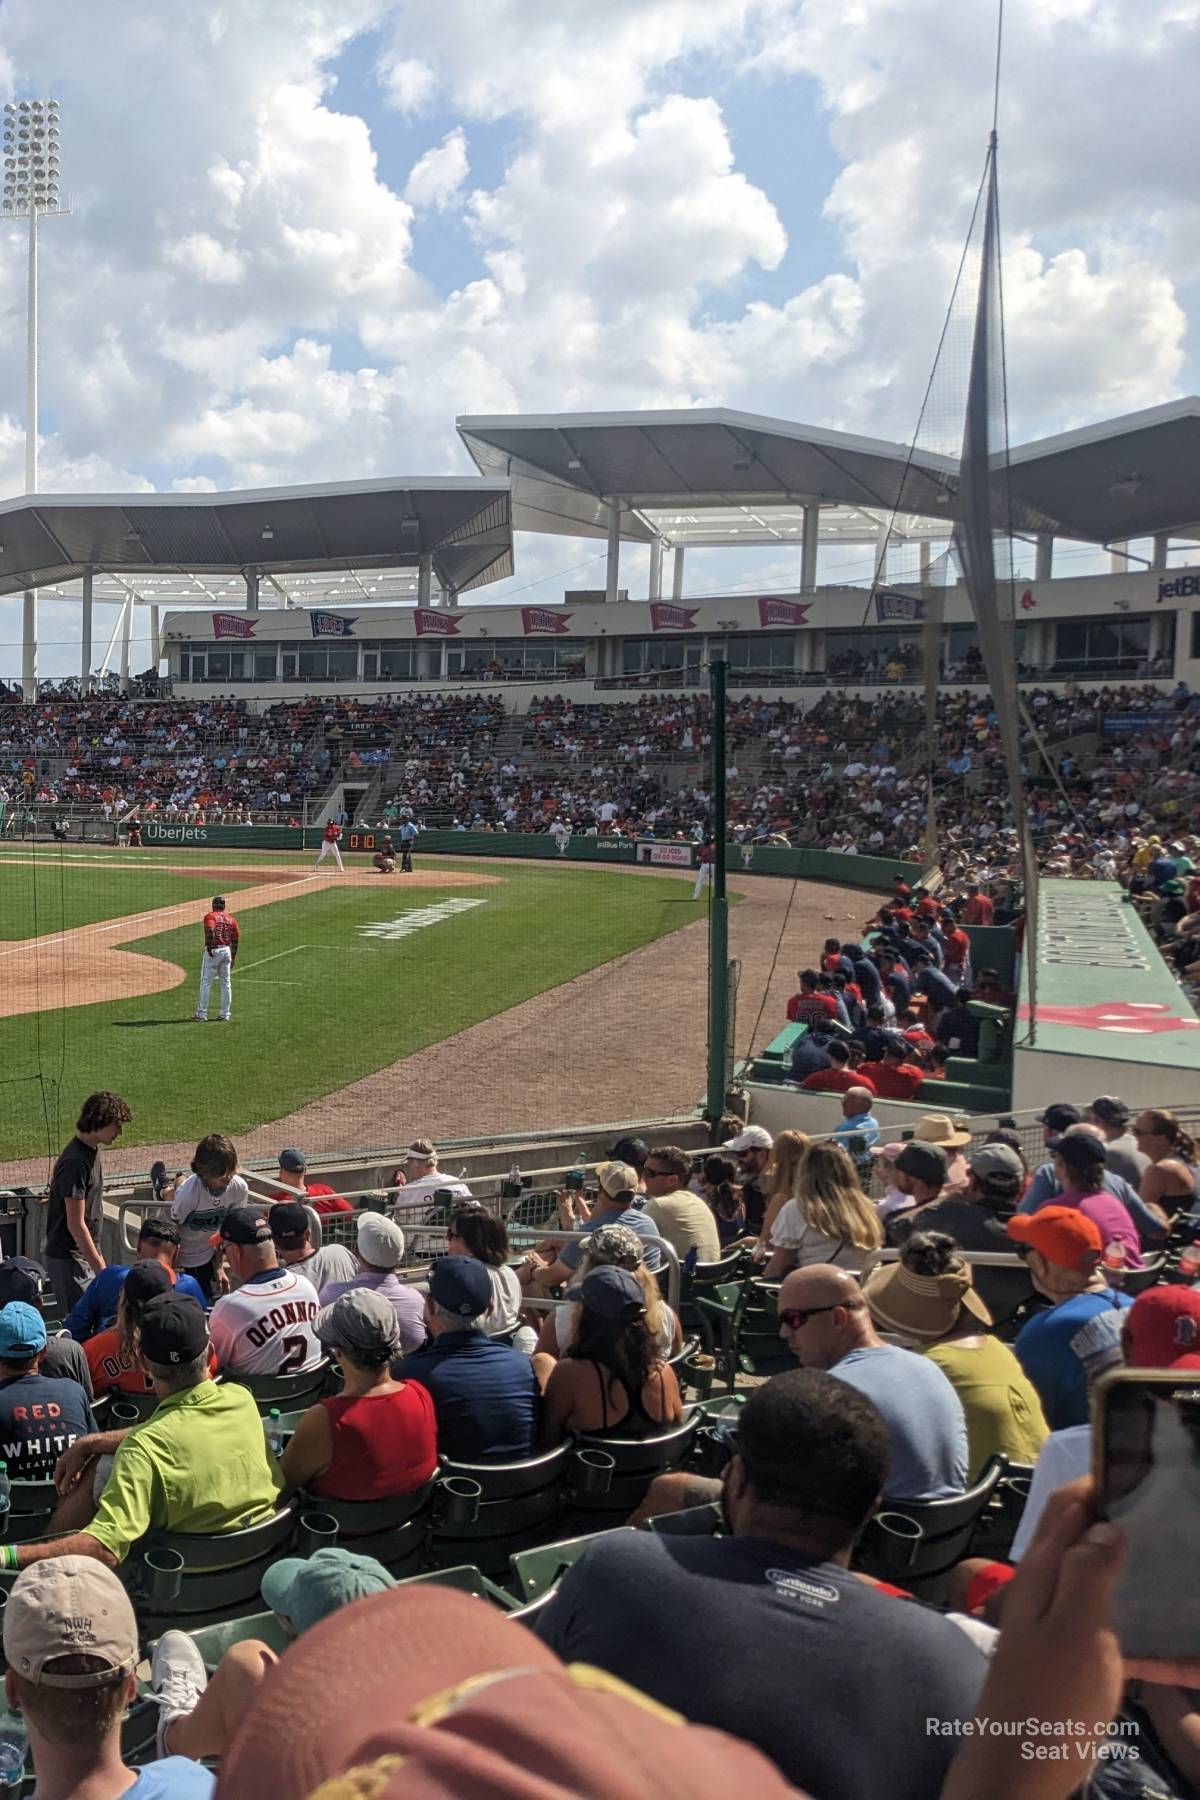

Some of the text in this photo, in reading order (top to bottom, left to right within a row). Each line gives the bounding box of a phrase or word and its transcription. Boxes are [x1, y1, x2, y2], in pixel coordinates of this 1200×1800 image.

[619, 841, 634, 849] Park
[247, 1301, 321, 1348] OCONNO
[280, 1334, 308, 1374] 2
[12, 1402, 61, 1421] RED
[64, 1616, 92, 1631] NWH
